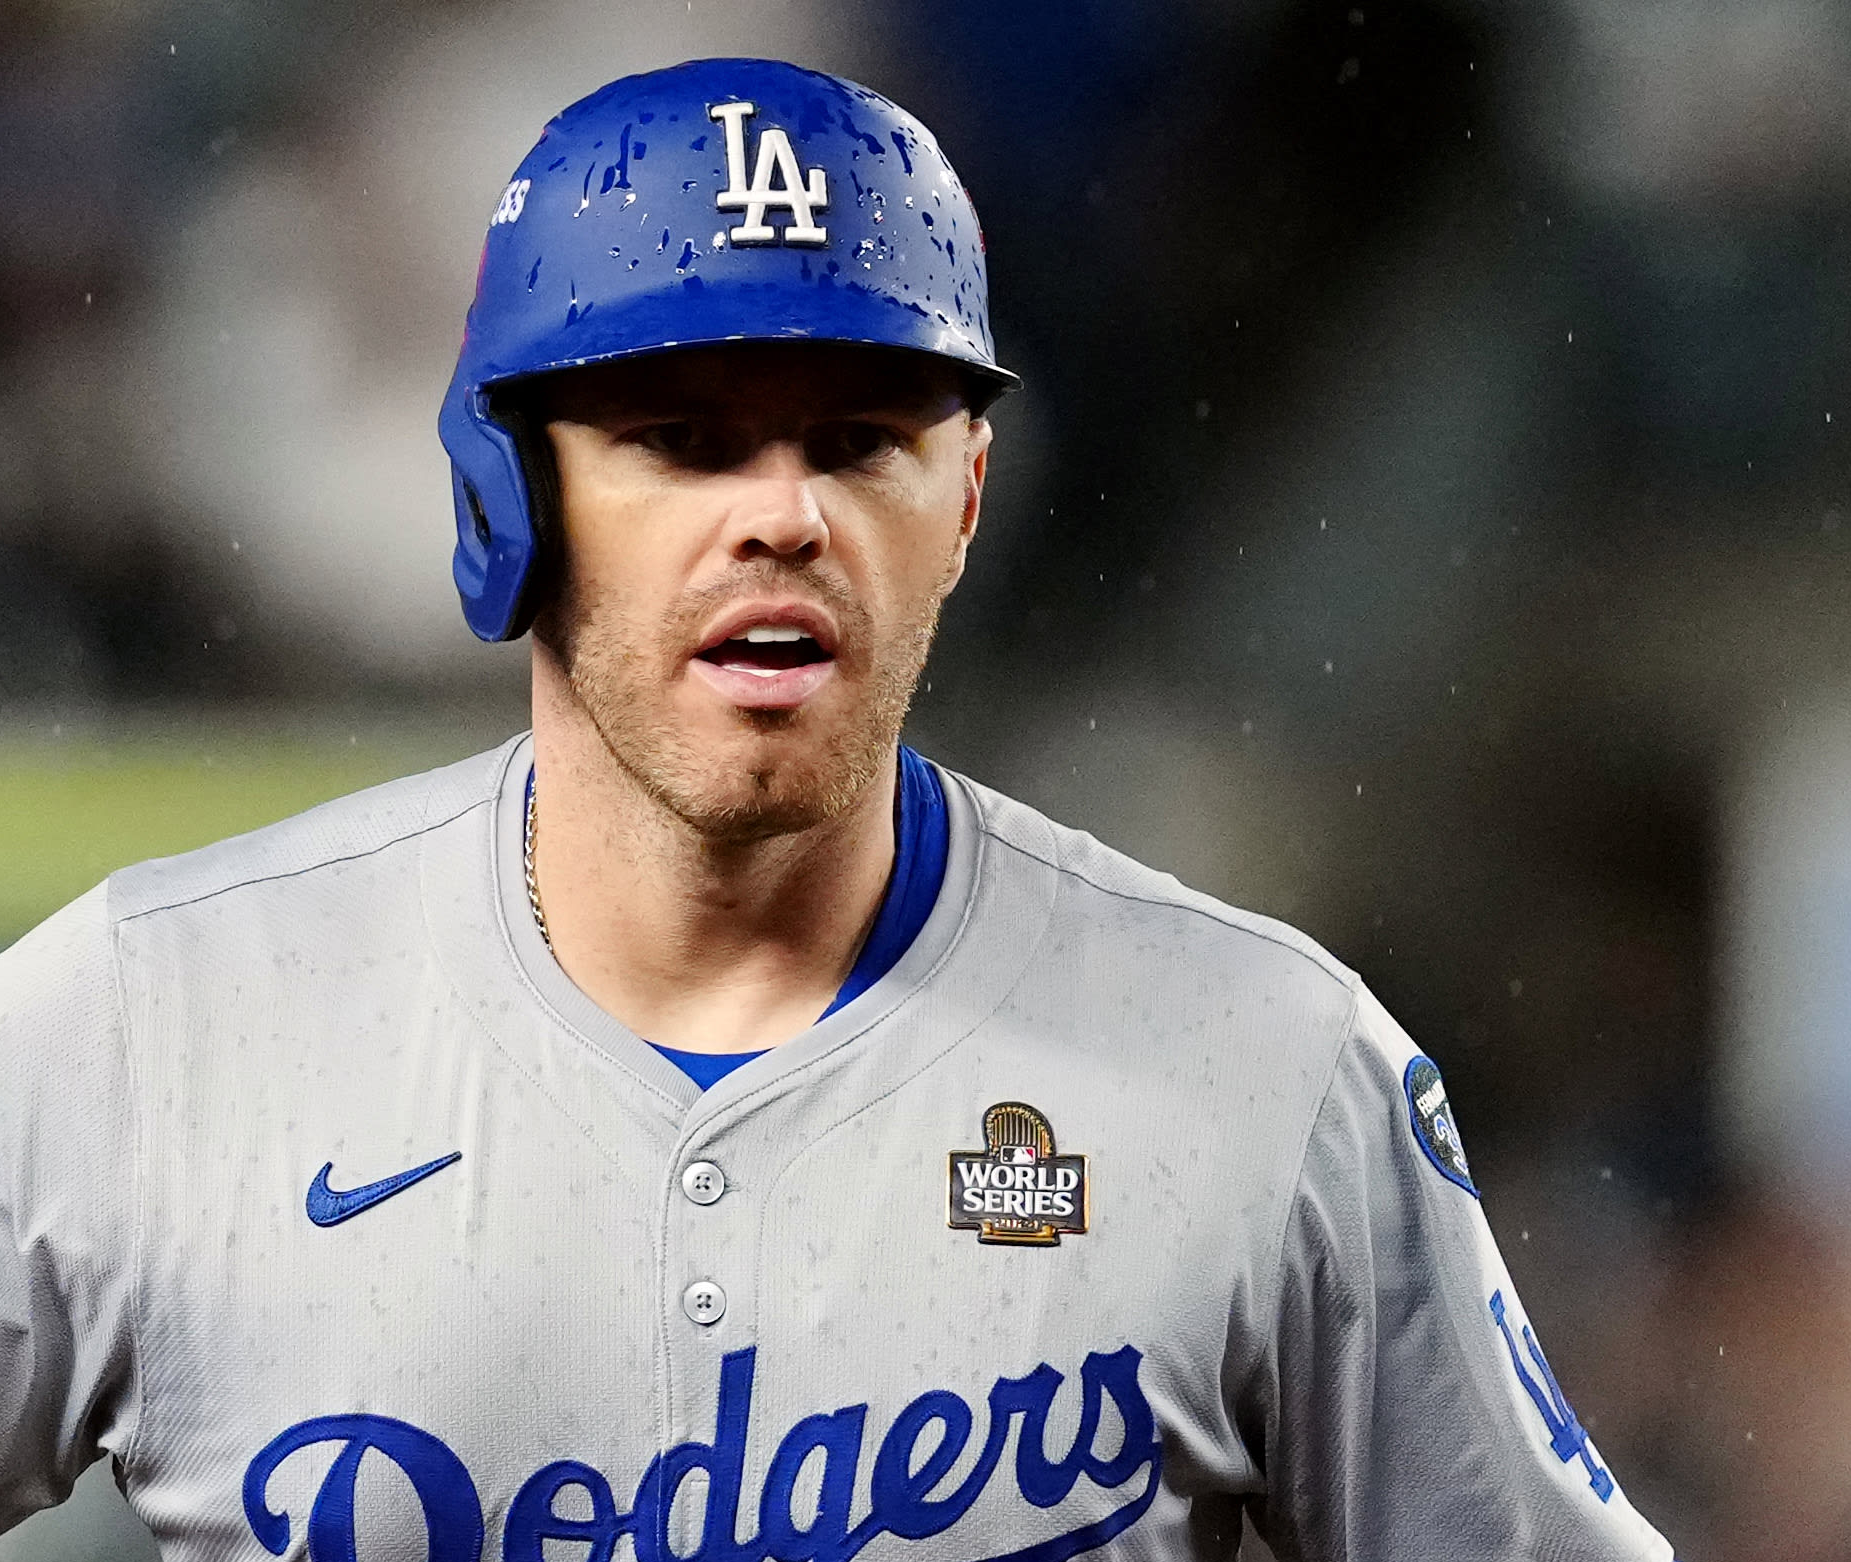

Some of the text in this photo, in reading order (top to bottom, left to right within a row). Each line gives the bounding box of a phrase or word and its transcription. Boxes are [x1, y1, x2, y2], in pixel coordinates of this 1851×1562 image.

[710, 102, 828, 242] LA
[957, 1162, 1079, 1191] WORLD
[963, 1187, 1074, 1218] SERIES
